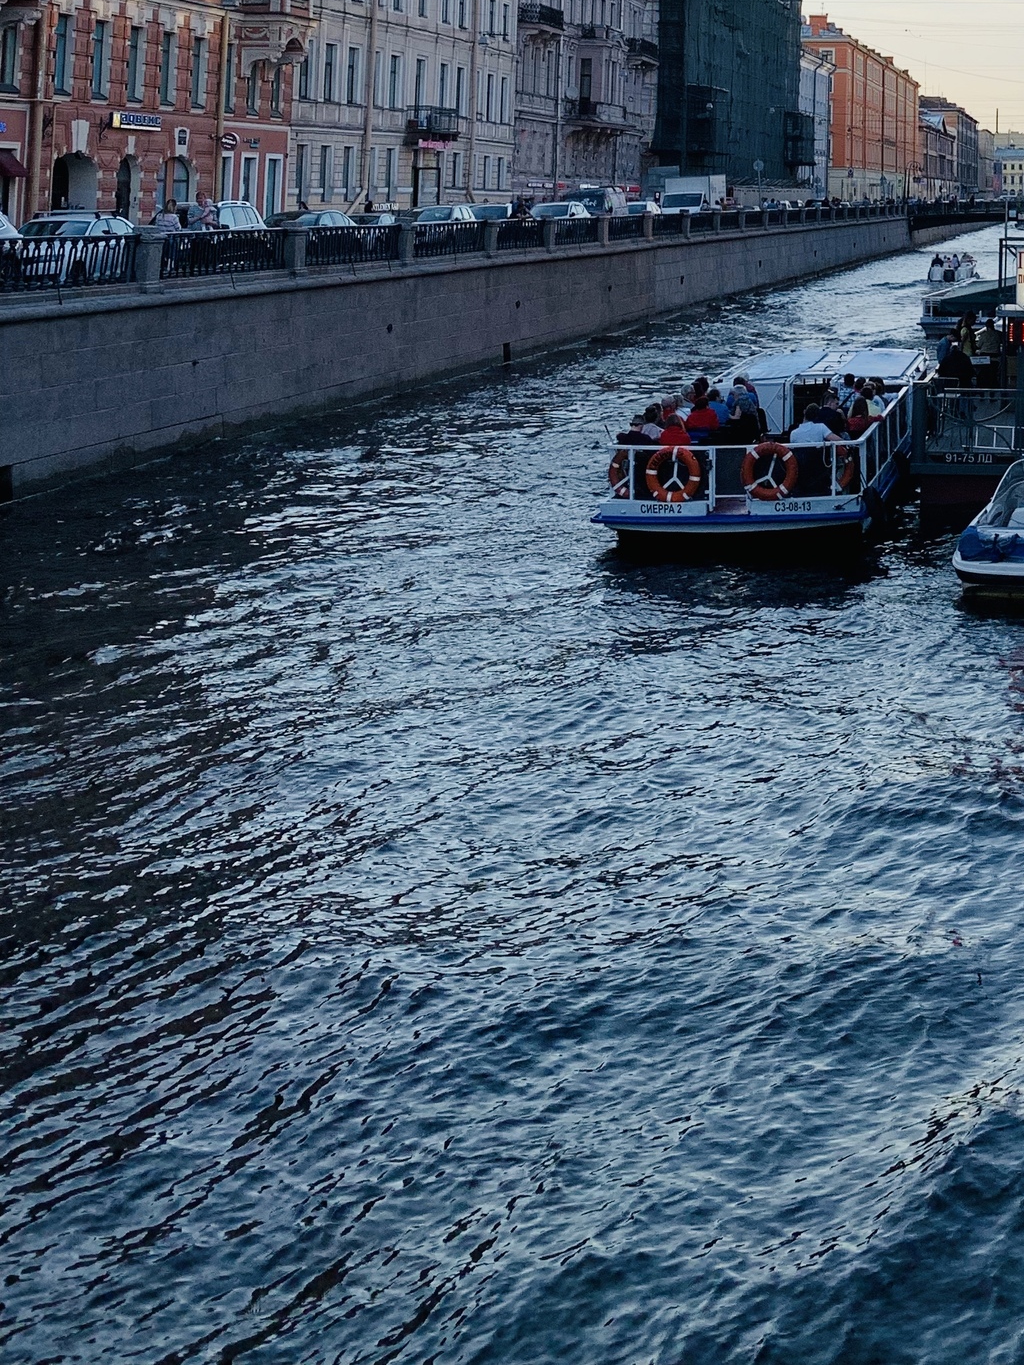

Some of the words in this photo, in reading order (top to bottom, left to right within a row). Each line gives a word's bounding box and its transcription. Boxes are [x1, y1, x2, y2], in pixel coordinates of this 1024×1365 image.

[945, 453, 975, 463] 91-75
[977, 453, 993, 463] ЛД
[640, 504, 675, 514] СИЕРРА
[676, 504, 682, 514] 2
